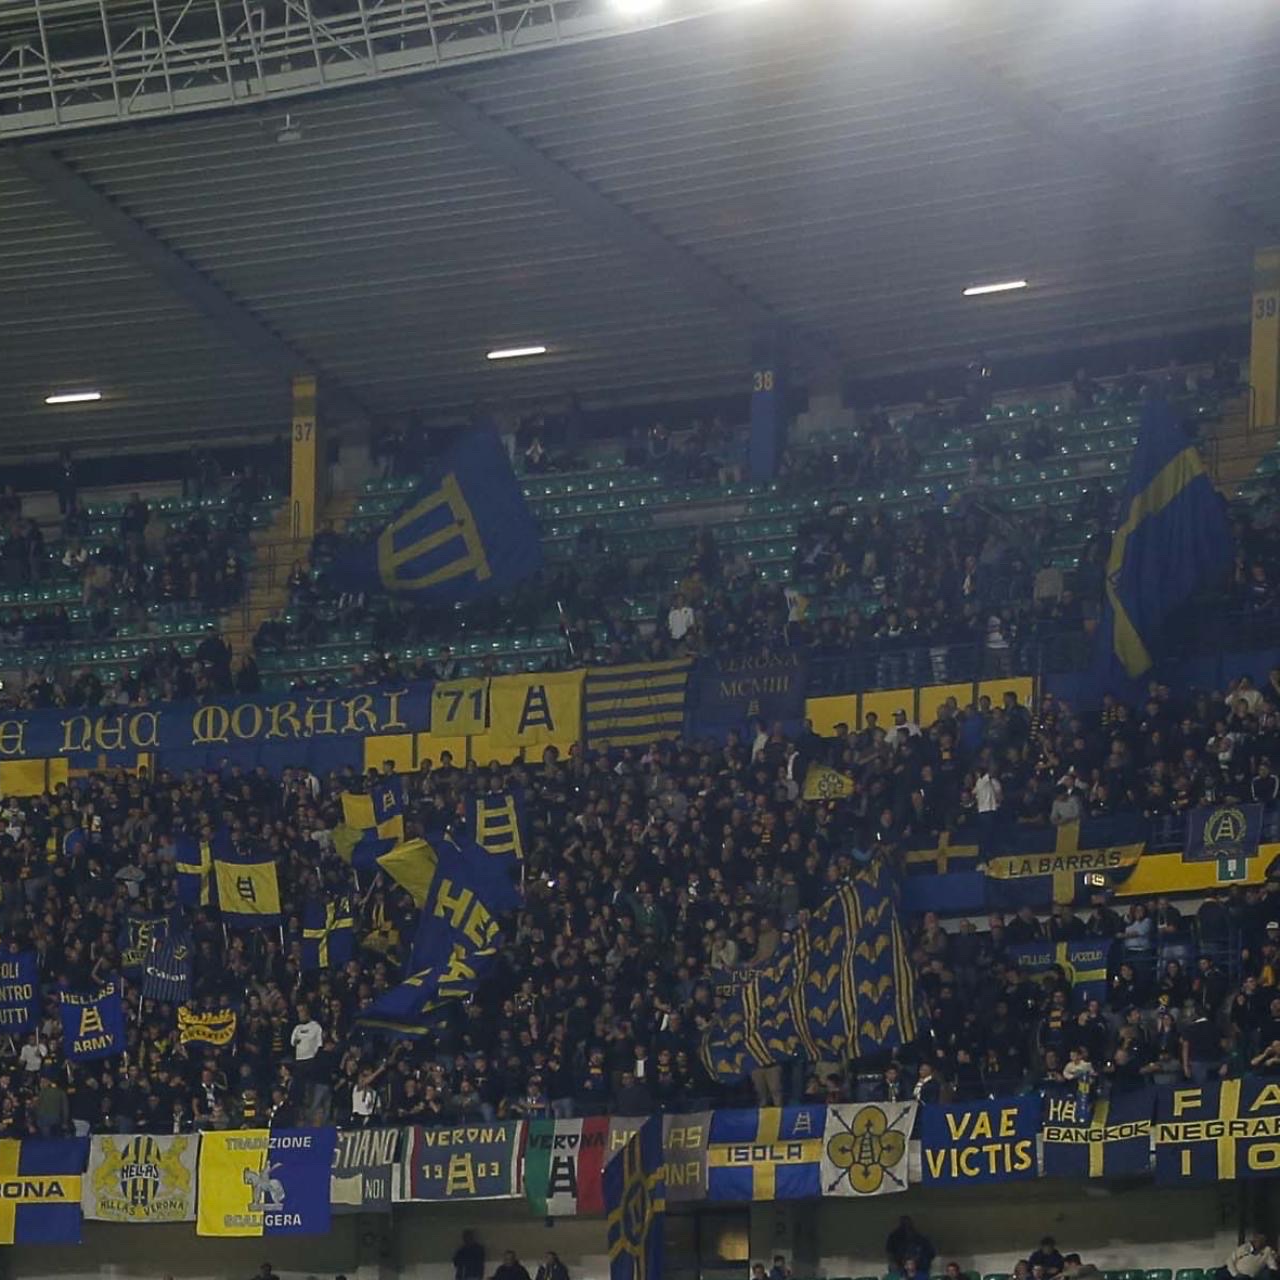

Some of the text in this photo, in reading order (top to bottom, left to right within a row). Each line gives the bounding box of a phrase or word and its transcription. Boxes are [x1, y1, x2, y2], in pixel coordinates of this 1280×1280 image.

[295, 424, 312, 441] 37
[1008, 861, 1034, 877] LA
[73, 1033, 114, 1053] ARMY
[945, 1108, 1019, 1141] VAE
[1045, 1120, 1151, 1143] BANGKOK
[1159, 1117, 1280, 1142] NEGRA
[225, 1136, 312, 1150] TRADIZIONE
[425, 1127, 507, 1146] VERONA
[727, 1143, 803, 1163] ISOLA
[925, 1139, 1033, 1179] VICTIS
[365, 1178, 386, 1200] NOI
